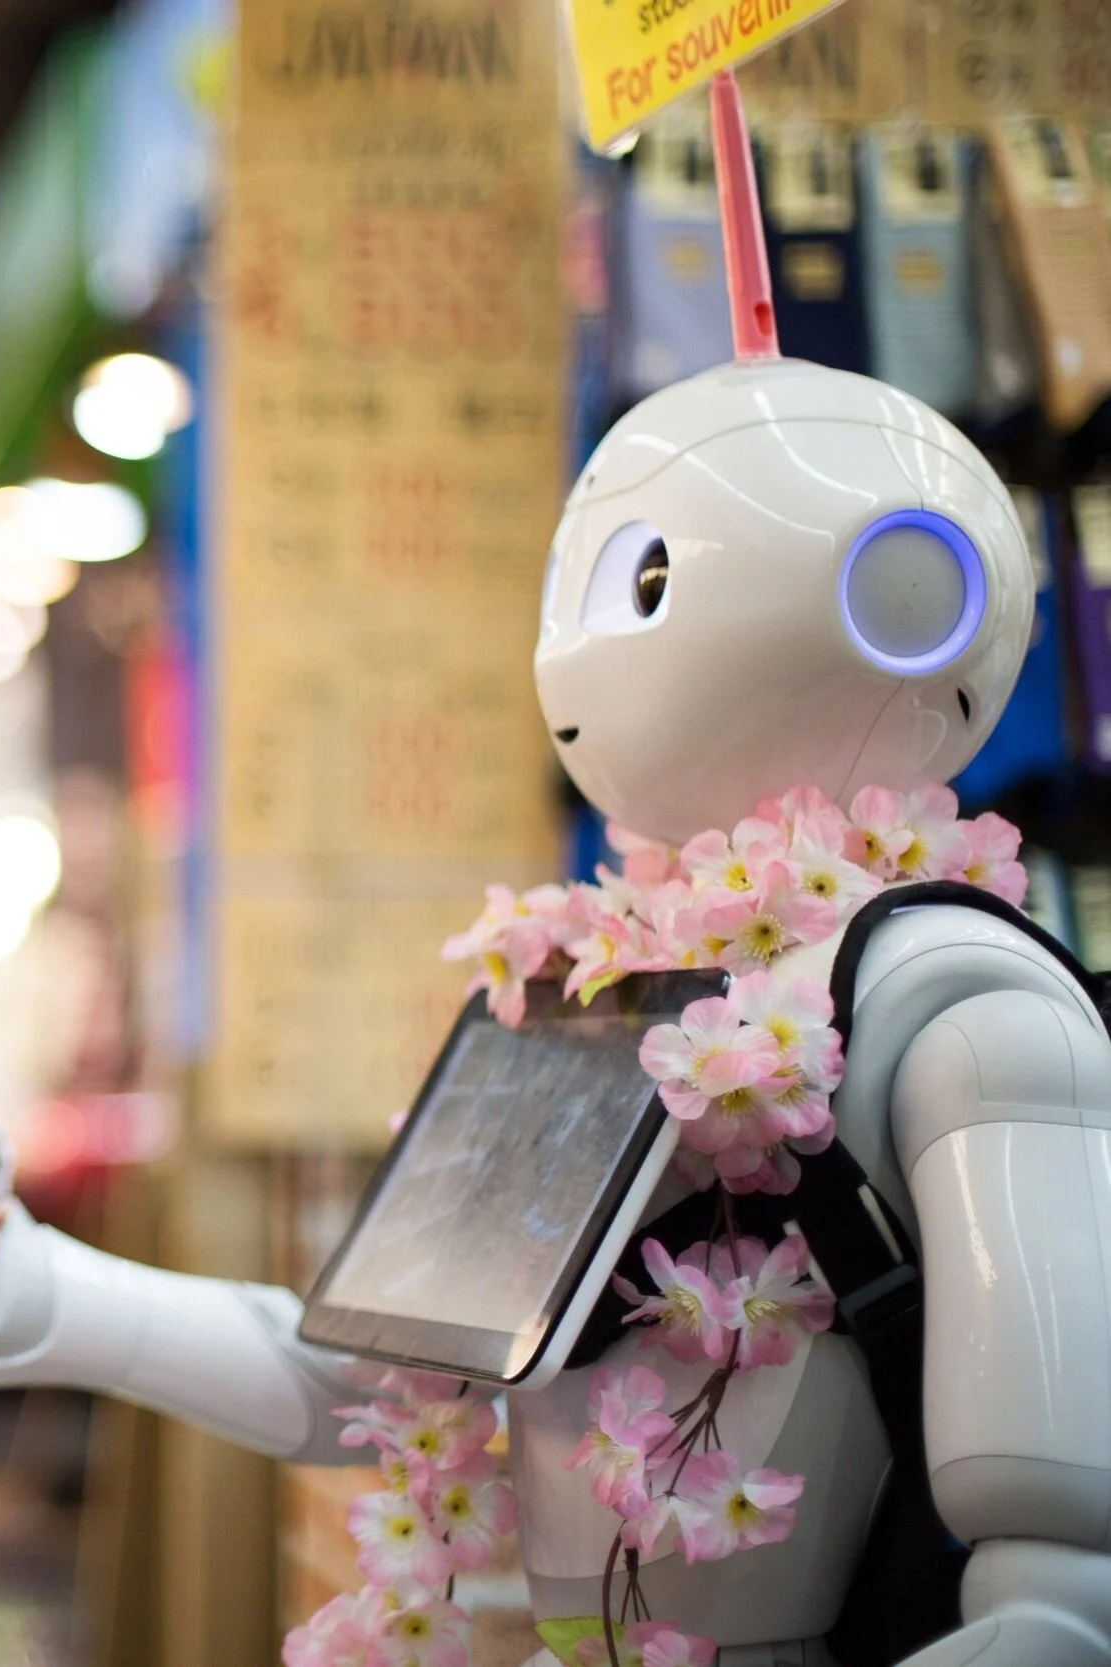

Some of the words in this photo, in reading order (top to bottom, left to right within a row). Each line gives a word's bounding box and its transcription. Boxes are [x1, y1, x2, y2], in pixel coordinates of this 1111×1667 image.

[638, 0, 693, 35] sto
[605, 56, 658, 121] For
[666, 0, 791, 82] souven
